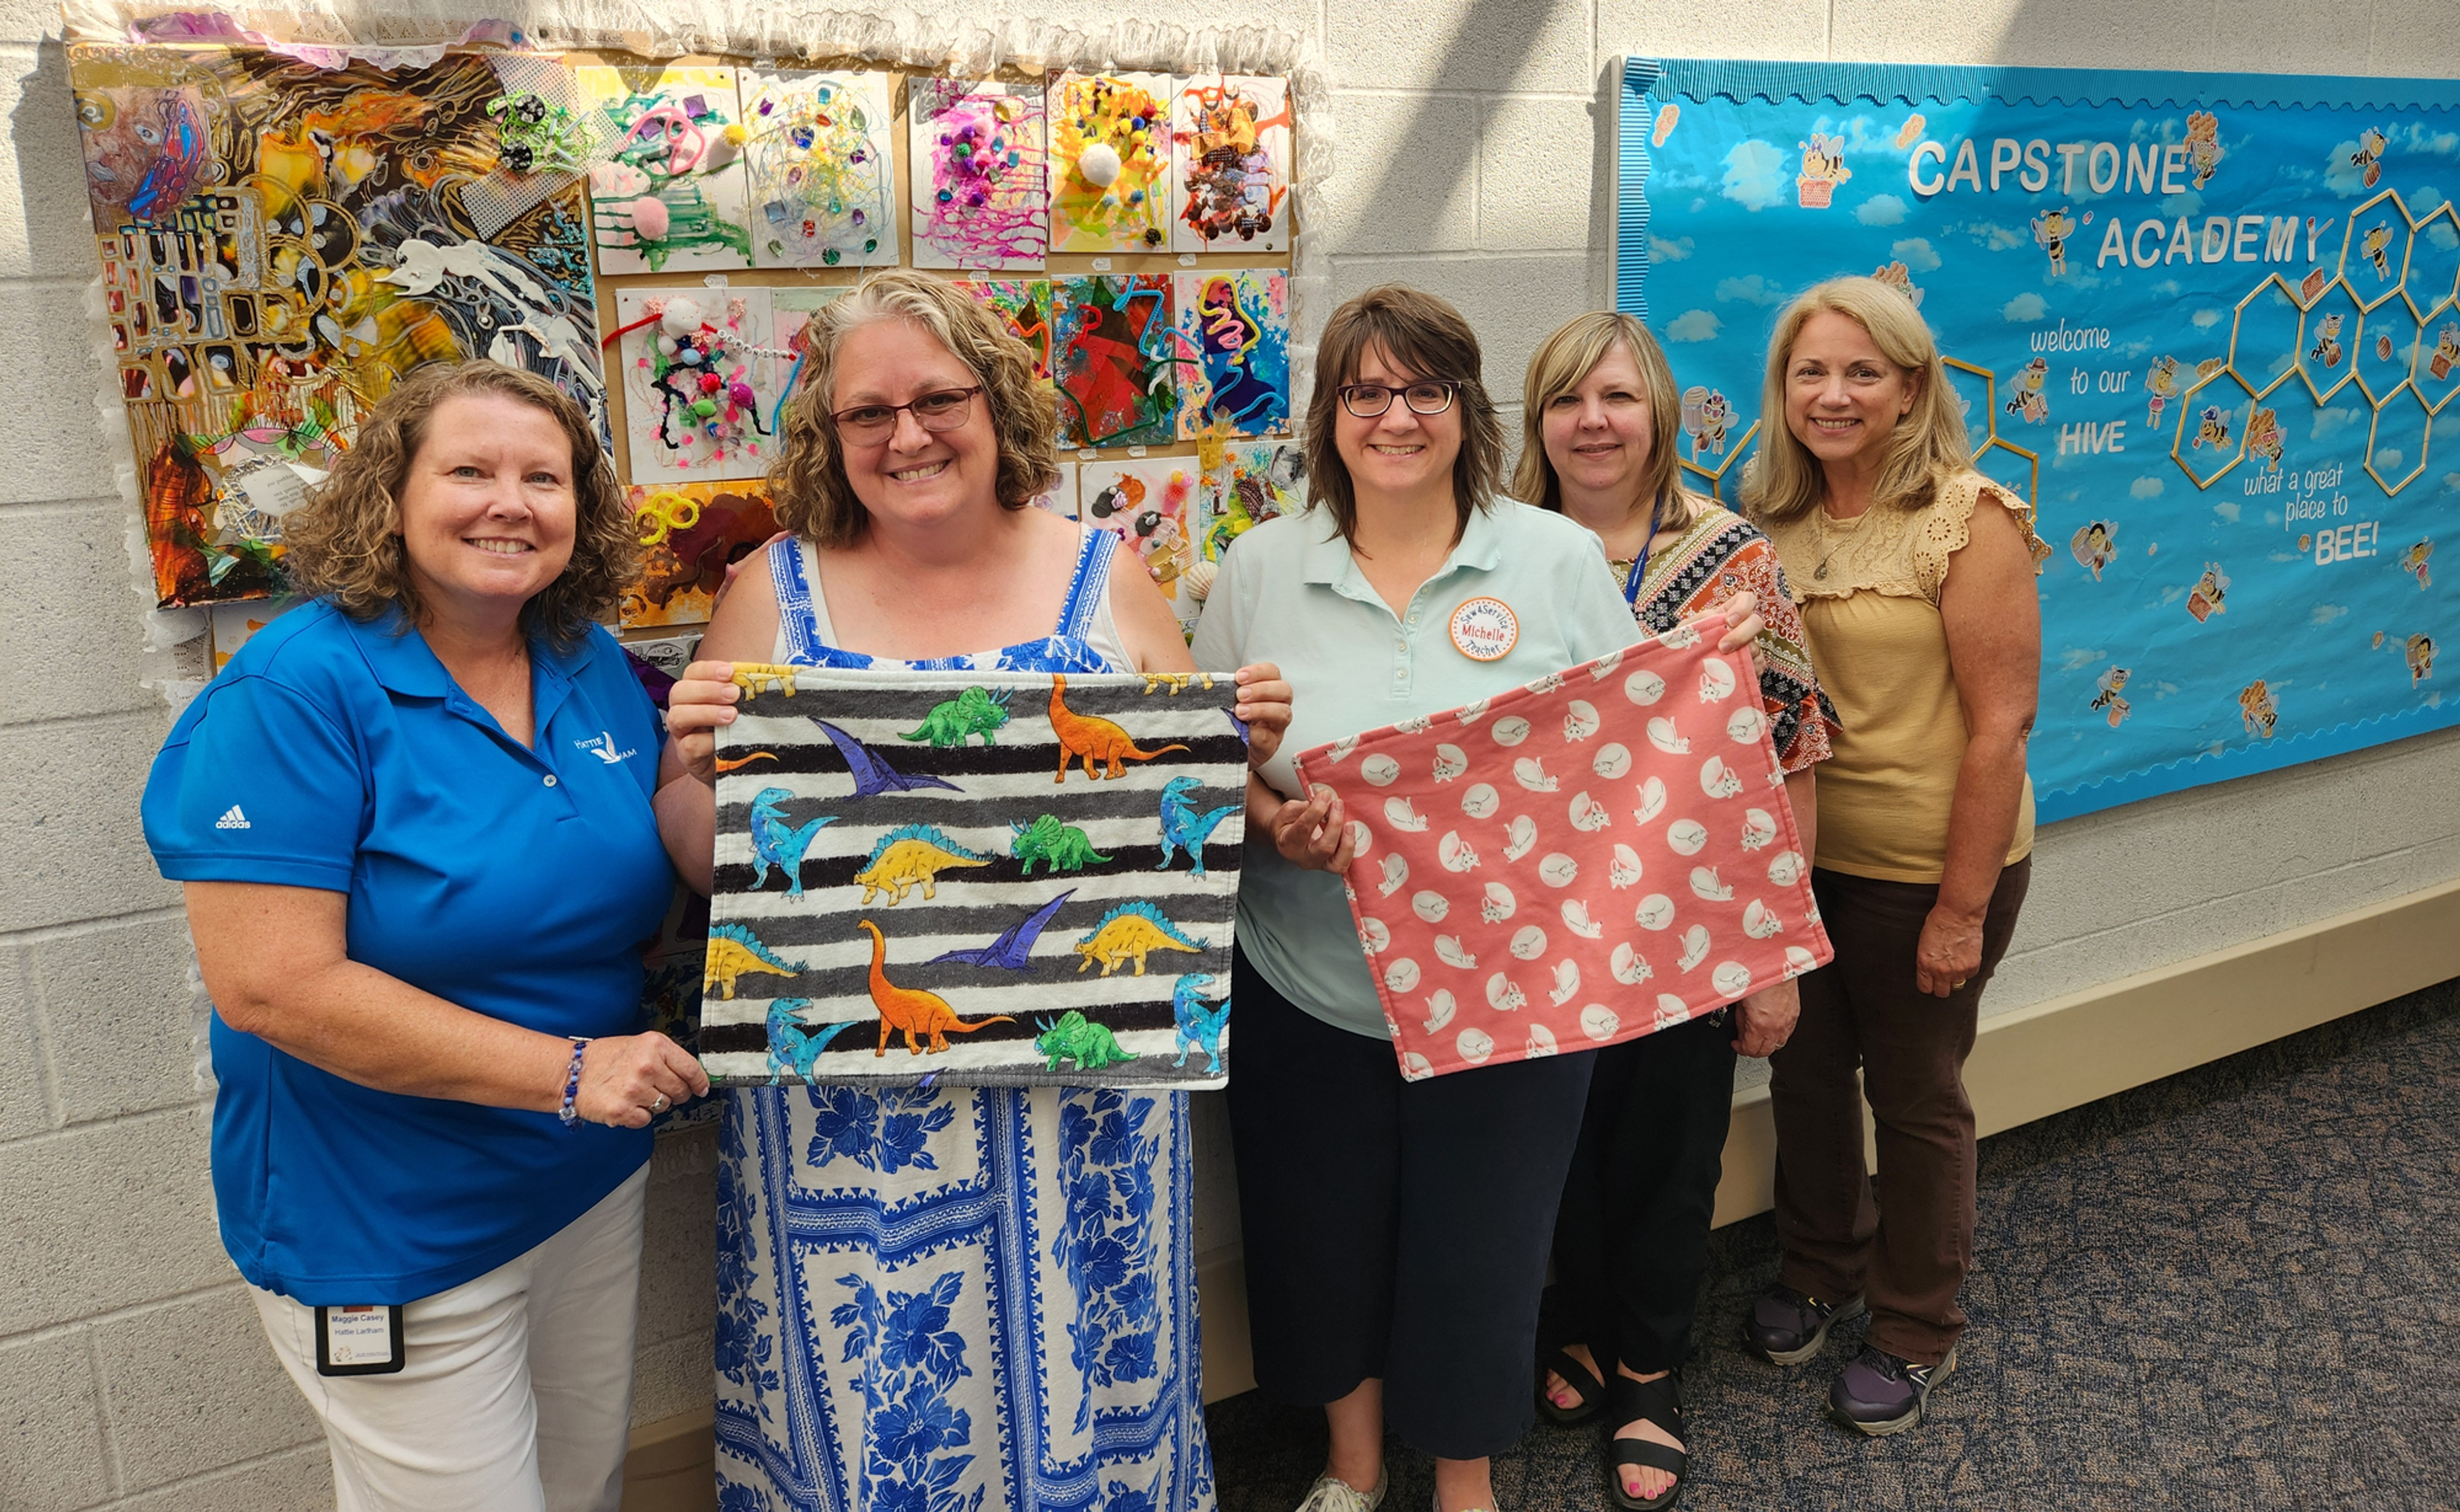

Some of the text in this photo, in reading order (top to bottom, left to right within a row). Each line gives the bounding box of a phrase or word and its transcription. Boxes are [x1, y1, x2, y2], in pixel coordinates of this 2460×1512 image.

[1909, 138, 2188, 196] CAPSTONE
[2097, 215, 2335, 269] ACADEMY
[2031, 317, 2110, 352] welcome
[2070, 367, 2131, 394] to our
[2060, 421, 2127, 456] HIVE
[2245, 462, 2344, 497] what a great
[2285, 491, 2347, 531] place to
[2315, 521, 2379, 566] BEE!
[1462, 623, 1505, 641] Michelle
[1466, 639, 1501, 654] Teacher
[215, 820, 251, 829] adidas
[331, 1315, 359, 1324] Maggie
